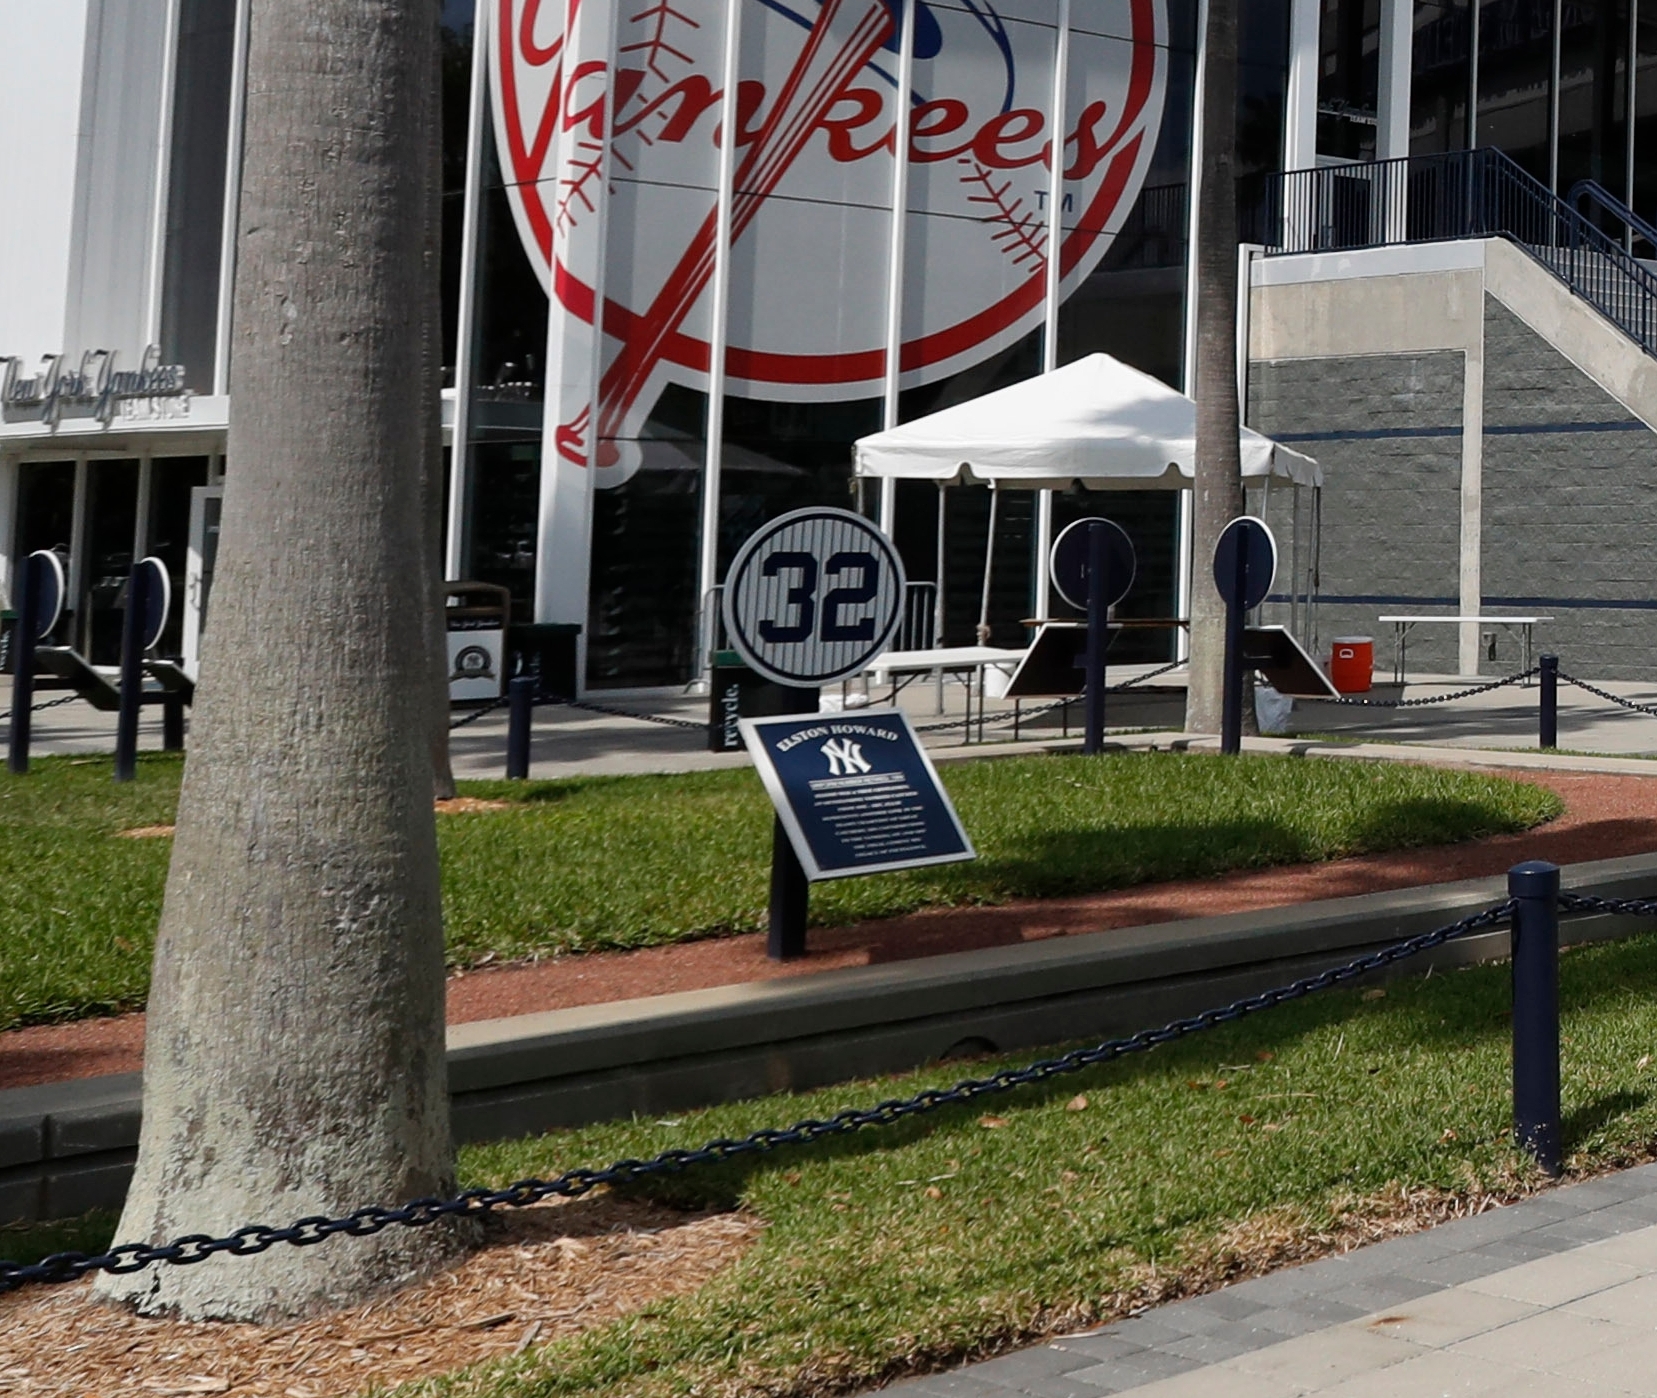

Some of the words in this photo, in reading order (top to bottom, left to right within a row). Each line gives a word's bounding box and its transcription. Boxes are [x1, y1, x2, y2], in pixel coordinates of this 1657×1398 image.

[758, 551, 880, 644] 32
[776, 726, 829, 752] ELSTON
[830, 724, 899, 742] HOWARD
